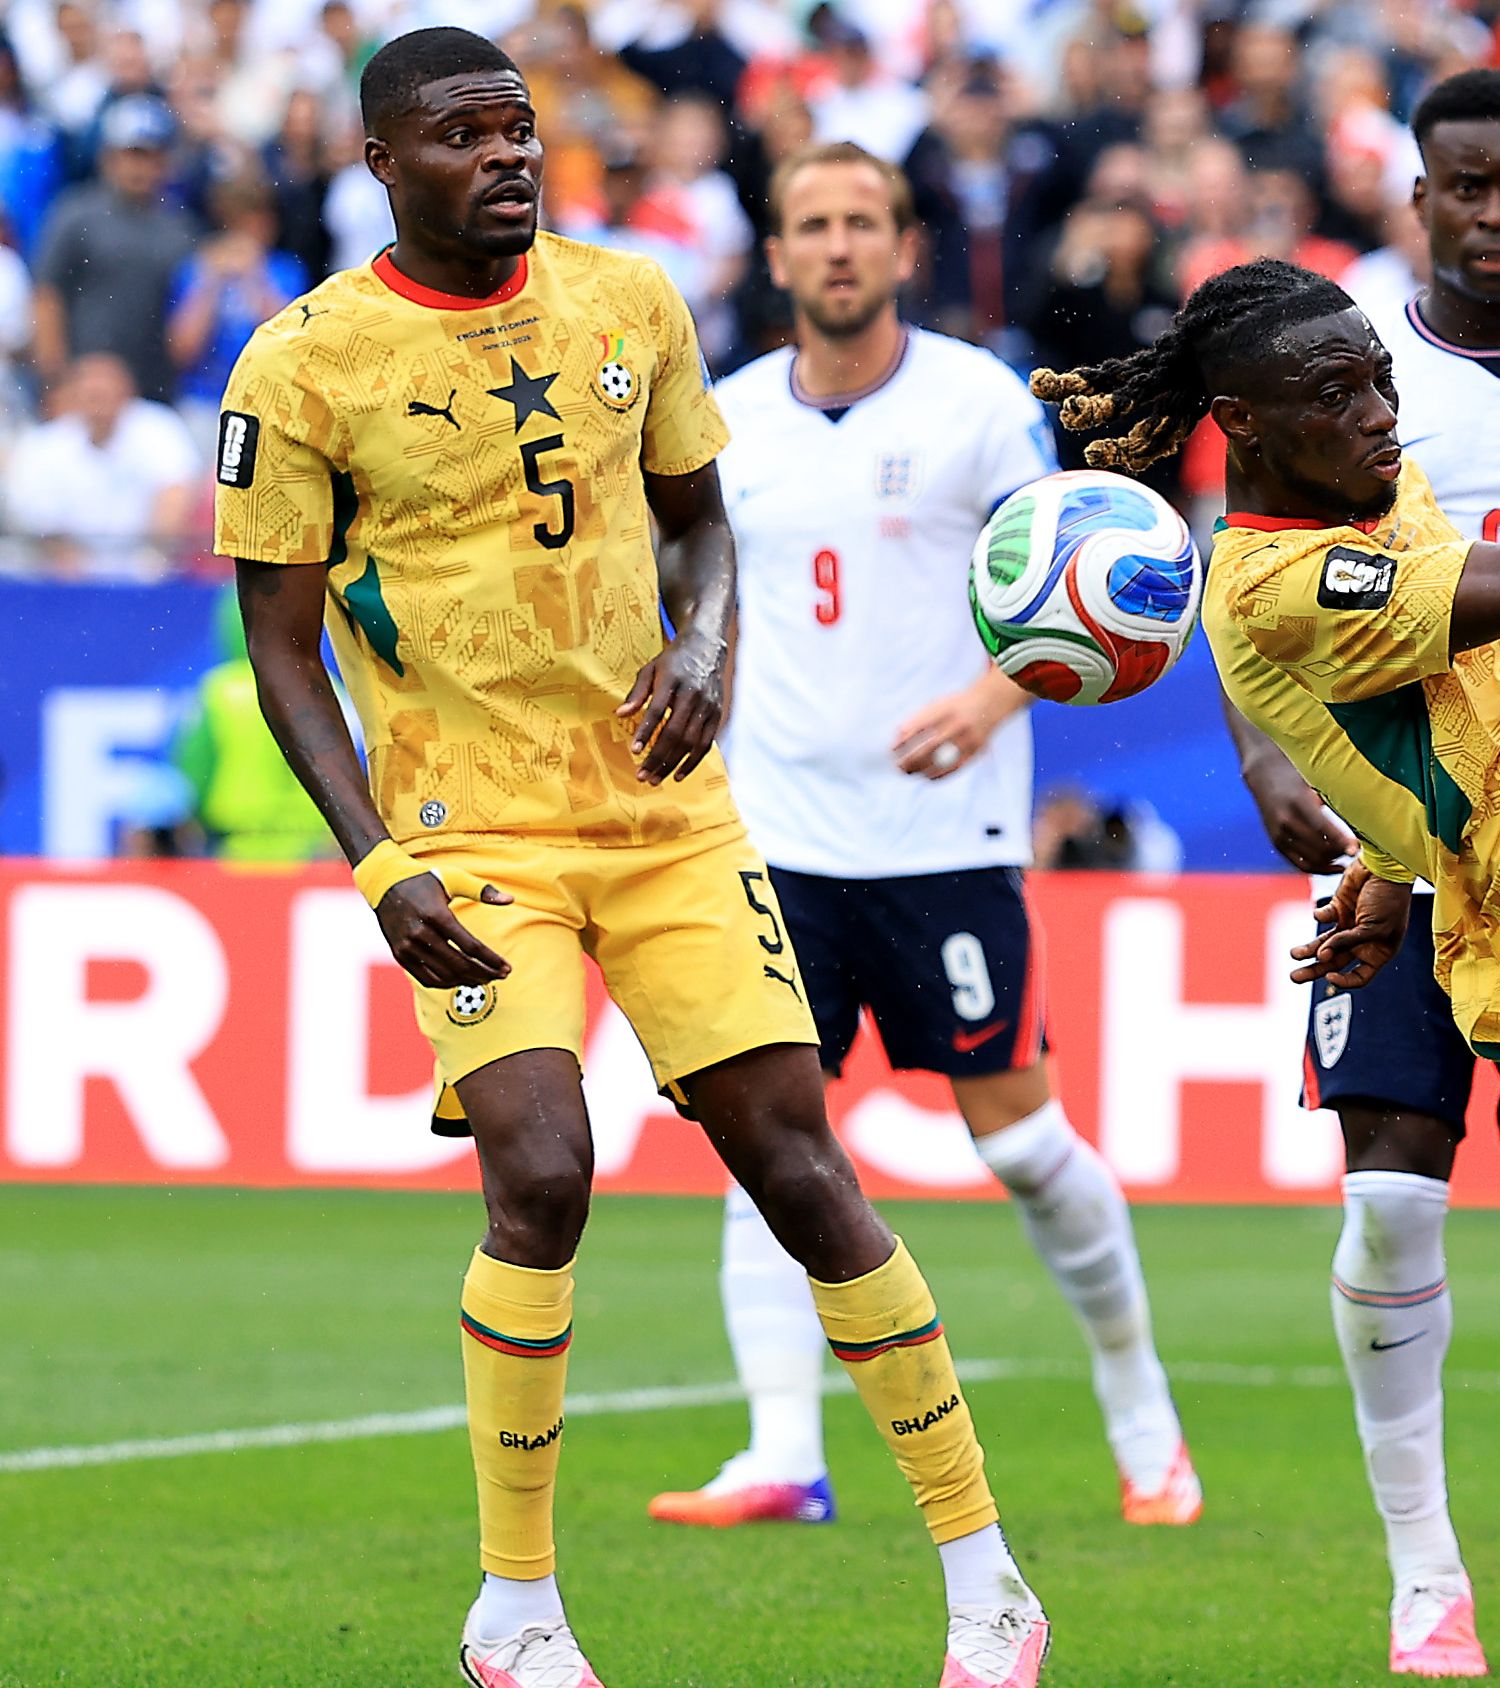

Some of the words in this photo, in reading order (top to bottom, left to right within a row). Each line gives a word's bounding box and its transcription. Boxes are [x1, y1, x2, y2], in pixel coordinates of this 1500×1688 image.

[519, 433, 576, 550] 5
[813, 549, 842, 626] 9
[738, 871, 784, 955] 5
[940, 931, 996, 1022] 9
[891, 1394, 959, 1436] GHANA
